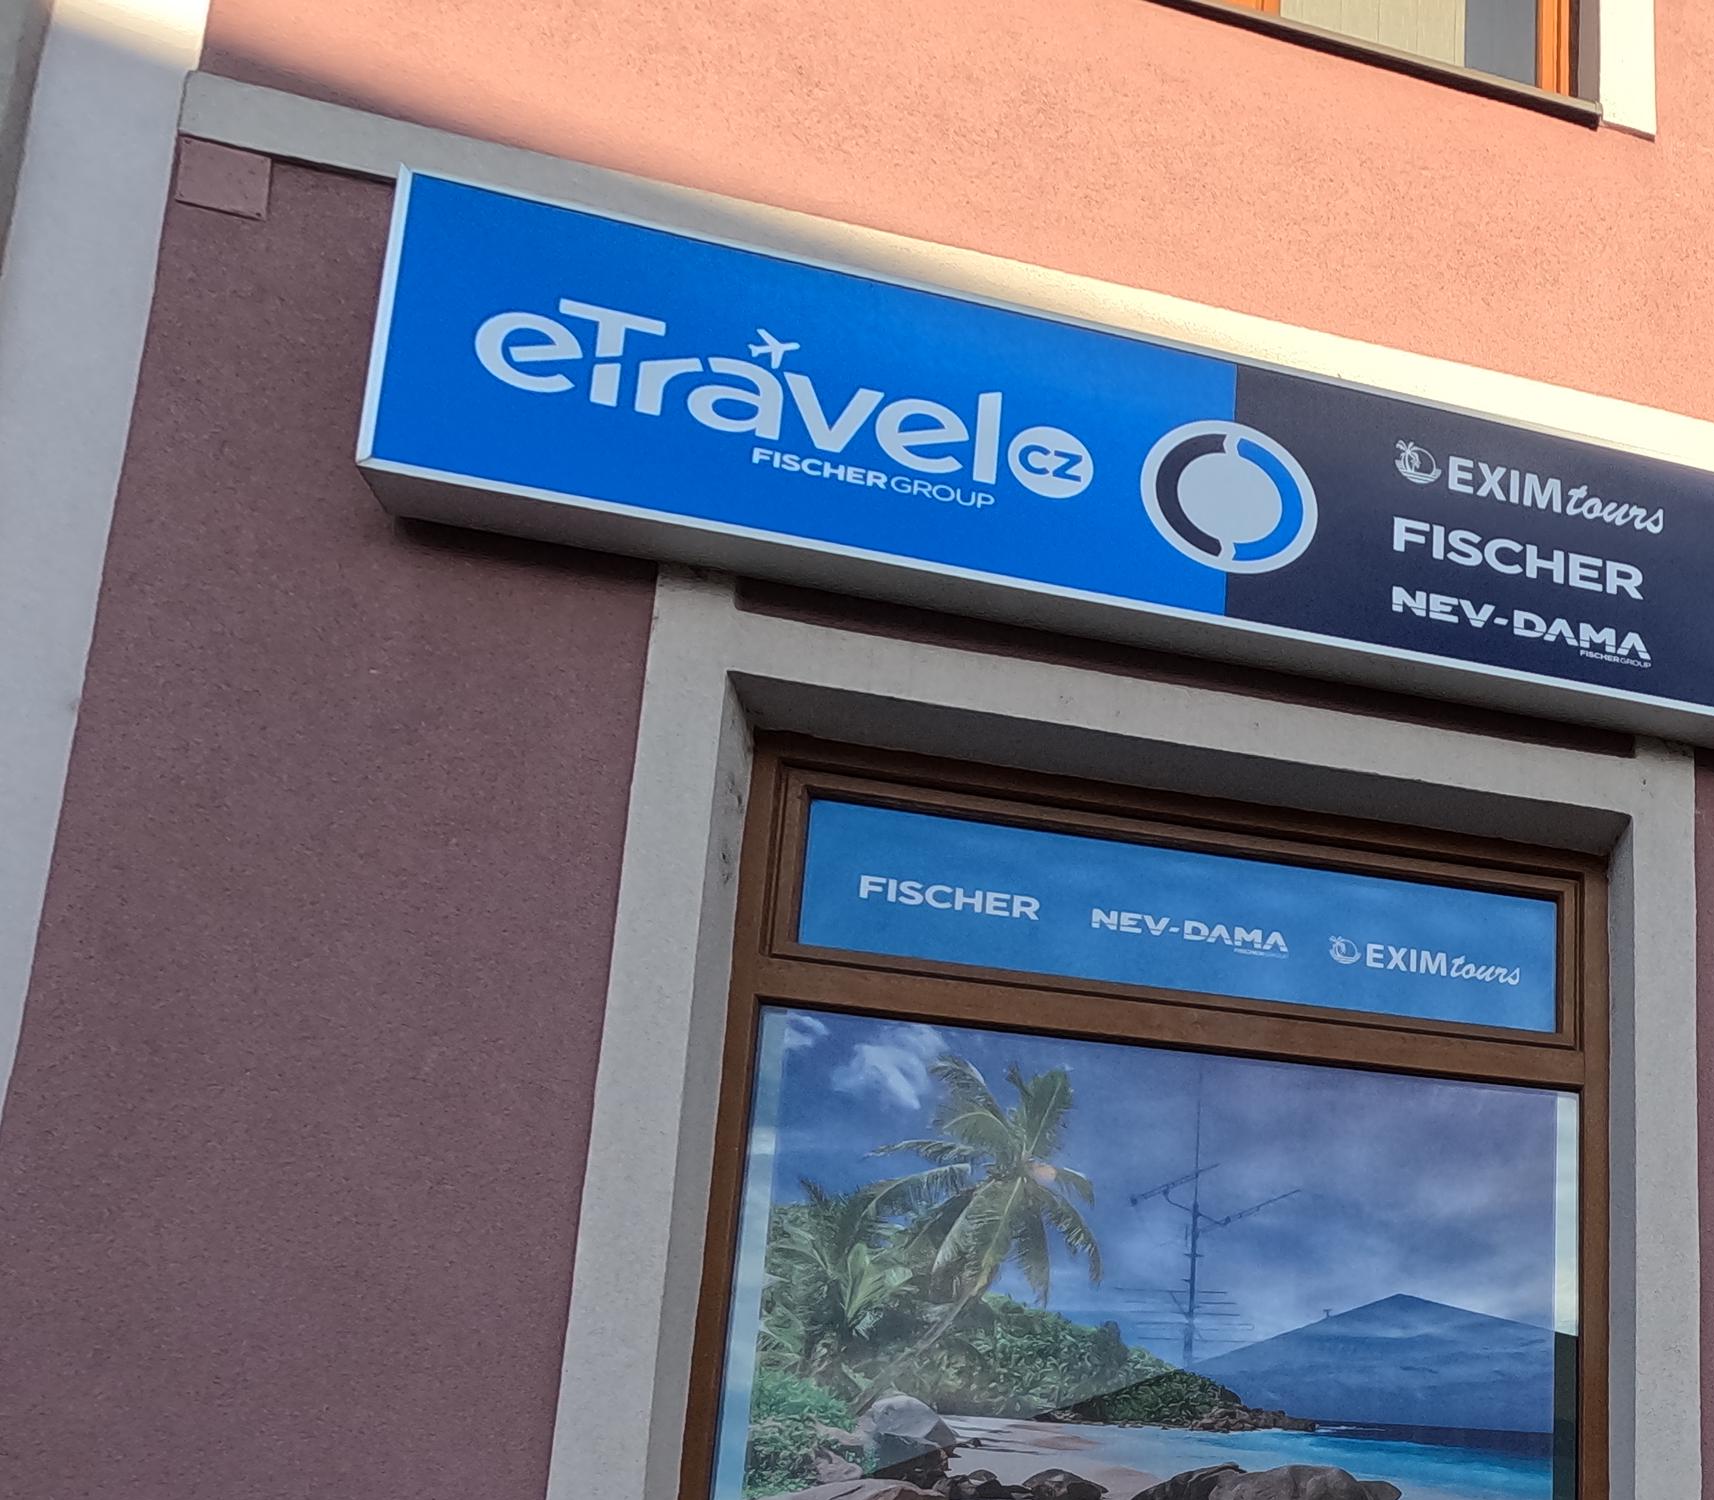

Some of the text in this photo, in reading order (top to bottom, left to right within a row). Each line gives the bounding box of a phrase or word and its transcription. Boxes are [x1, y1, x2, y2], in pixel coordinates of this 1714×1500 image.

[1448, 455, 1665, 534] EXIMtours
[1392, 516, 1644, 600] FISCHER
[1392, 586, 1652, 661] NEV-DAMA
[858, 874, 1040, 921] FISCHER
[1090, 908, 1288, 952] NEV-DAMA
